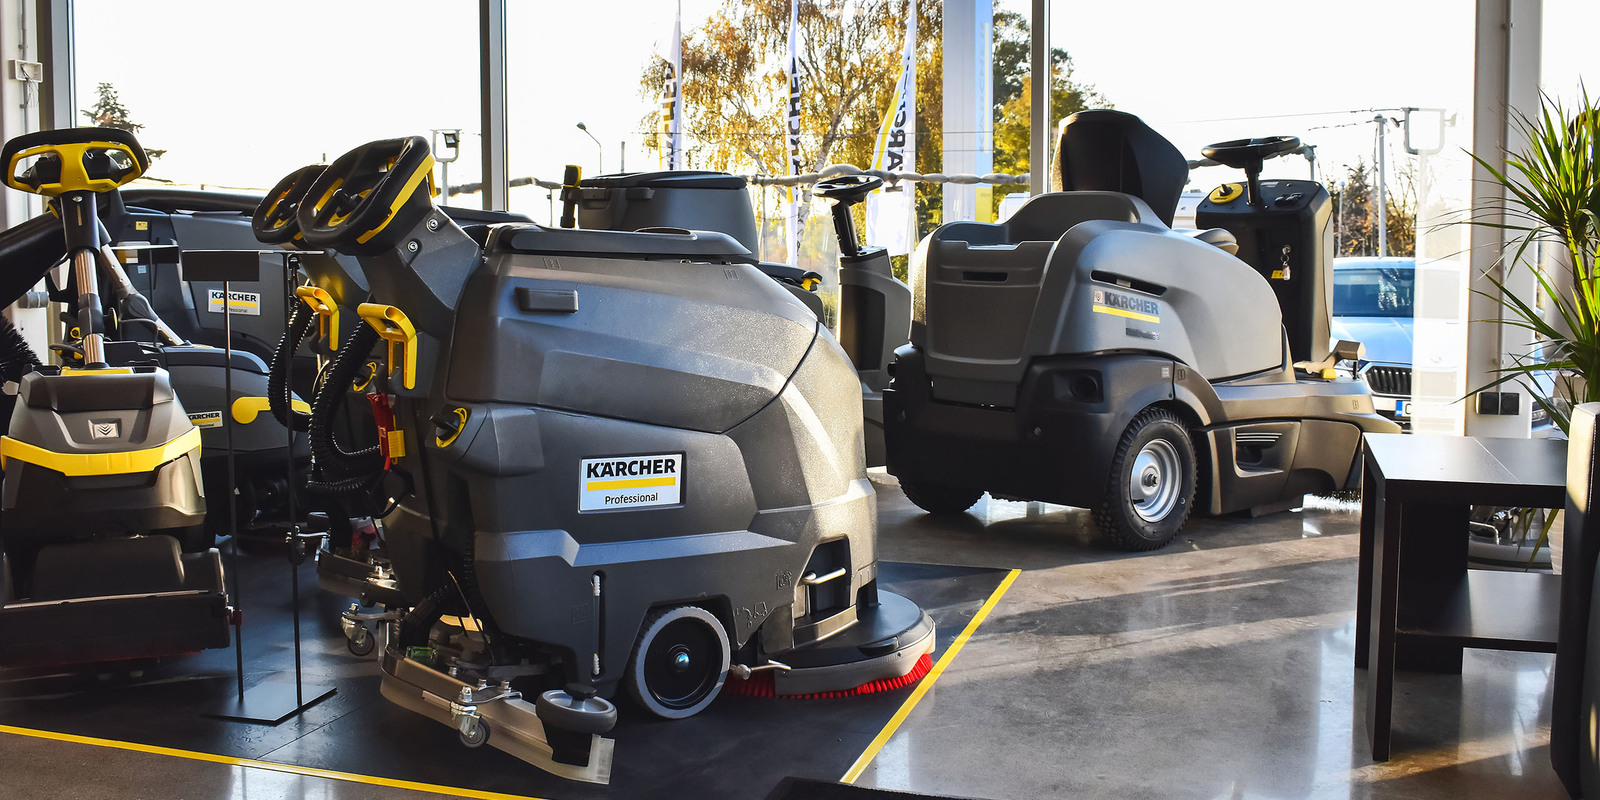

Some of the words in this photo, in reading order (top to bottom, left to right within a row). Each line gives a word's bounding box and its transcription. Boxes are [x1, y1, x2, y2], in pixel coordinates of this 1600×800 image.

[1104, 291, 1159, 315] KÄRCHER
[586, 458, 676, 478] KÄRCHER
[604, 492, 658, 505] Professional
